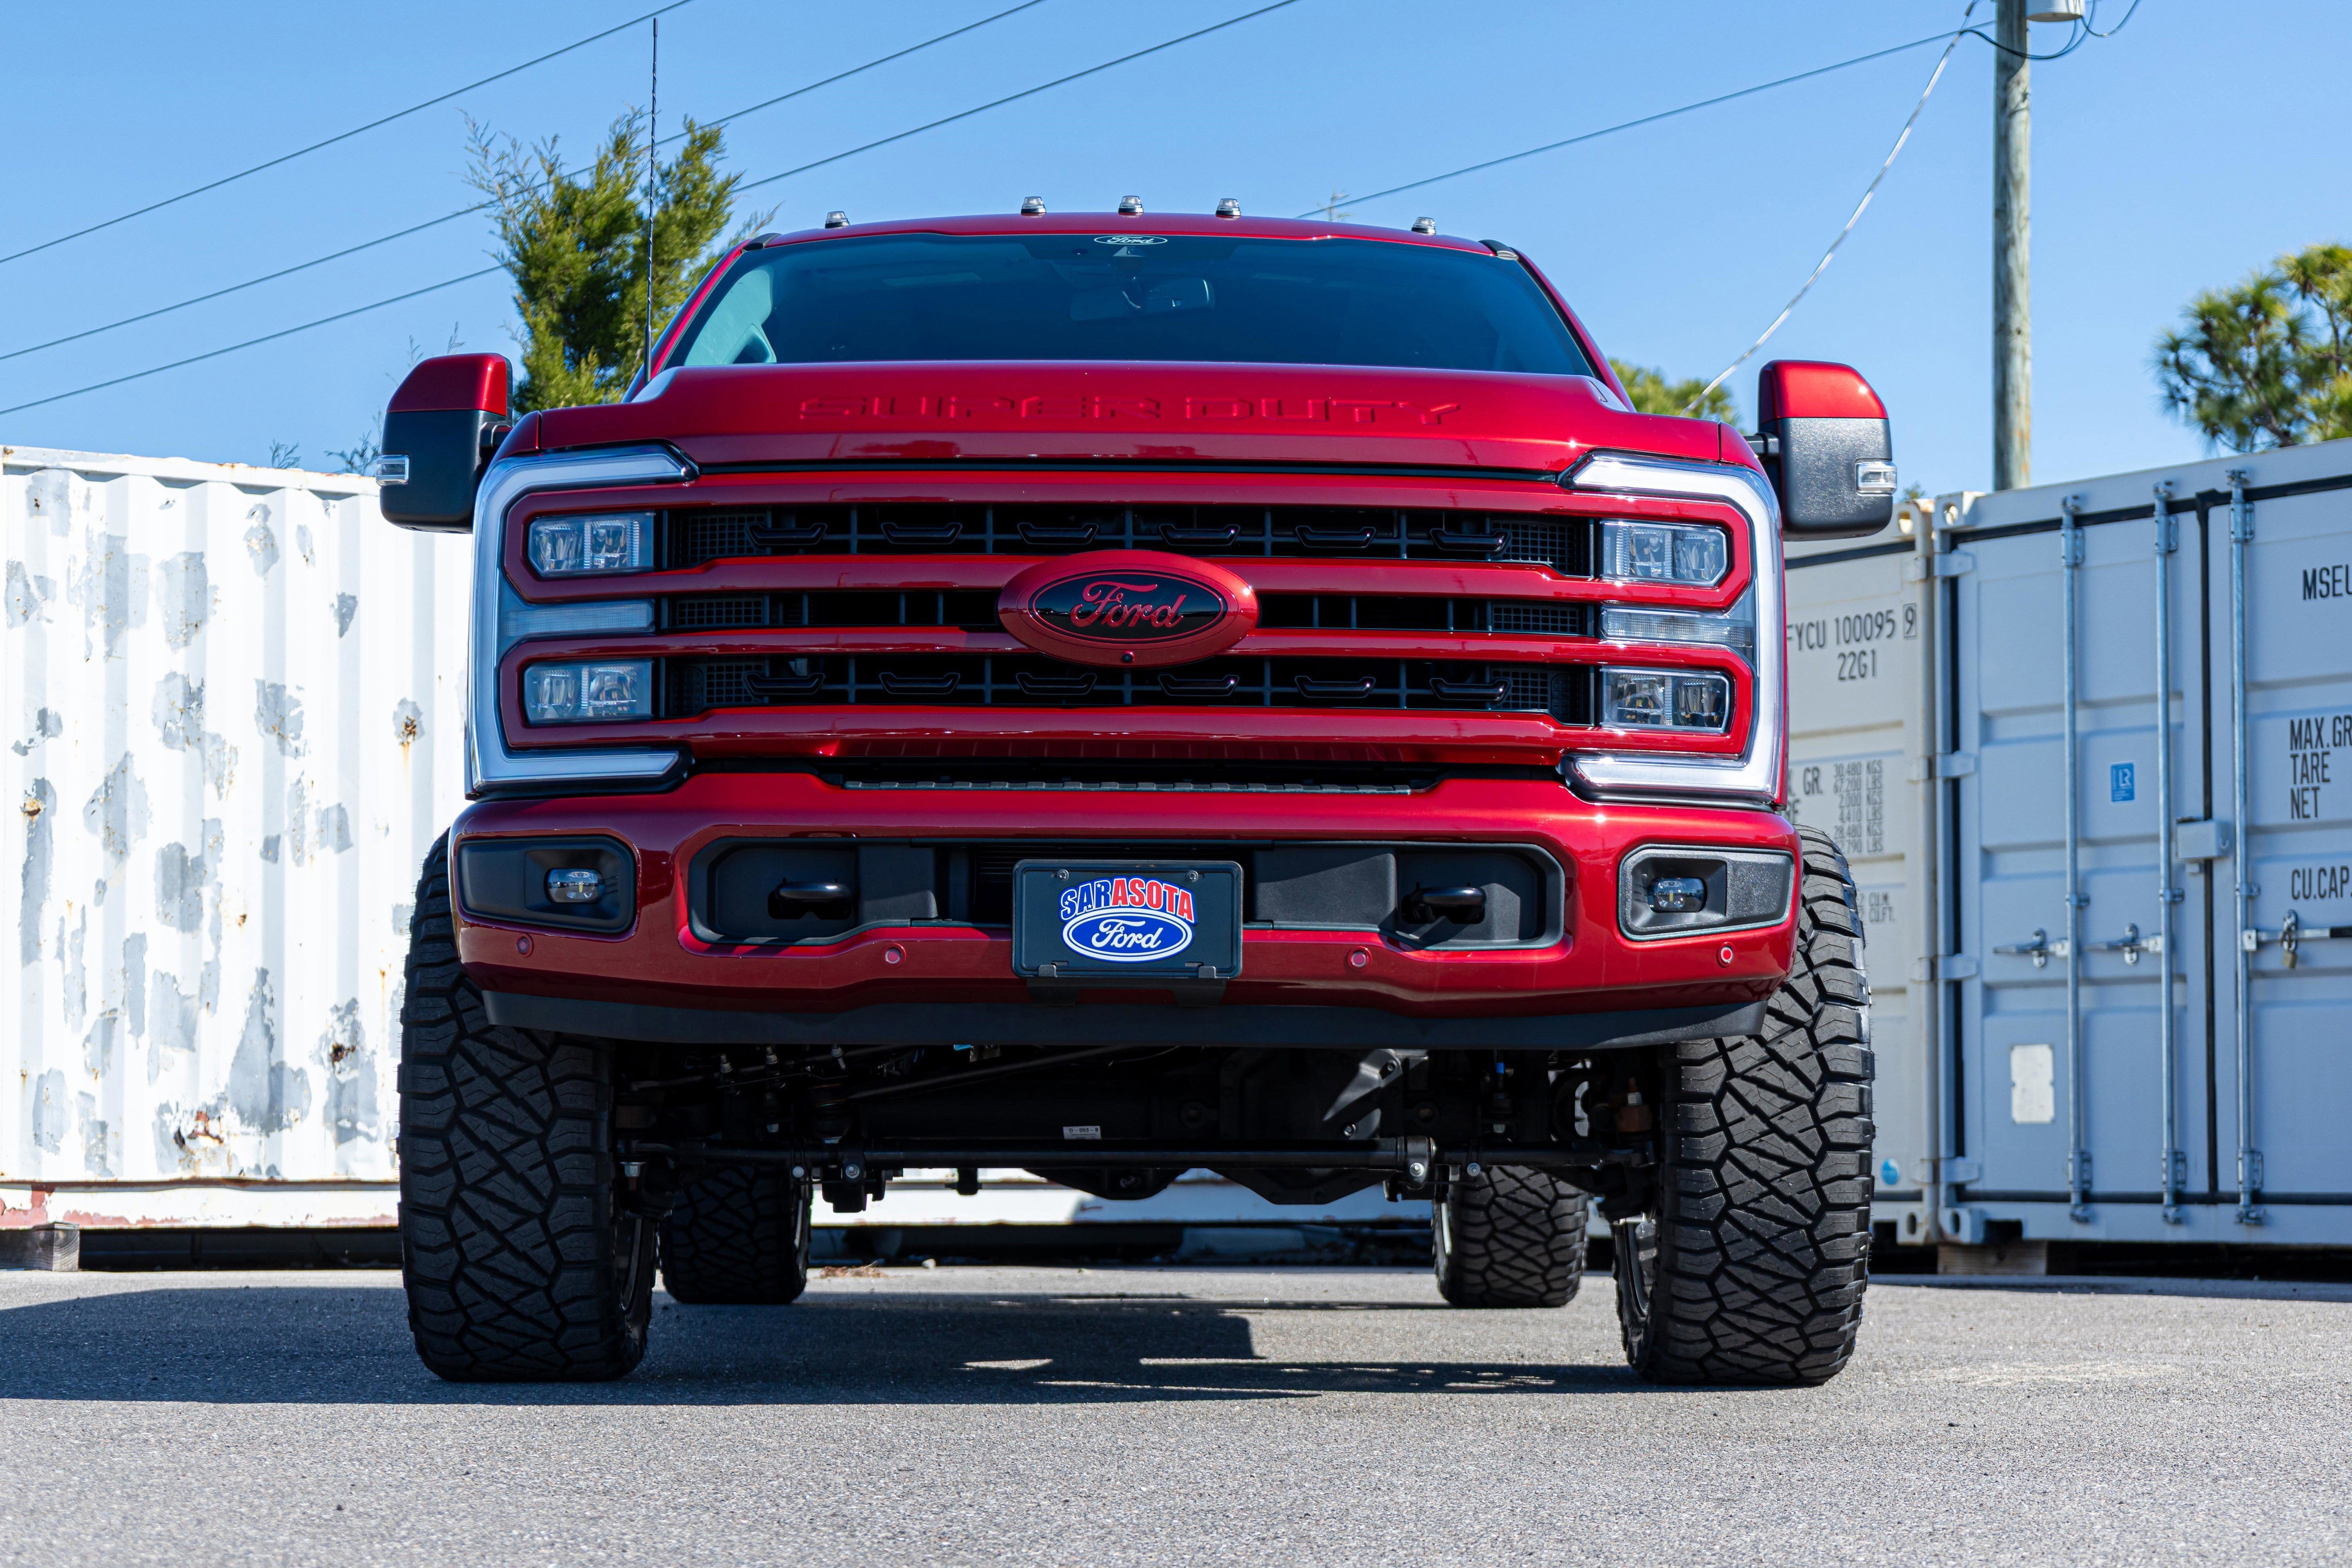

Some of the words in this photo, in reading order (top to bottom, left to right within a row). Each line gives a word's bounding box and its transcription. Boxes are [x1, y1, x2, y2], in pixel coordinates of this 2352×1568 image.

[800, 396, 1160, 421] SUPER
[1185, 396, 1461, 425] DUTY
[1069, 581, 1187, 628] Ford
[1834, 609, 1895, 645] 100095
[1904, 606, 1915, 635] 9
[1838, 648, 1876, 680] 22G1
[2290, 750, 2331, 784] TARE
[2290, 785, 2320, 819] NET
[1060, 876, 1196, 924] SARASOTA
[1091, 919, 1164, 949] Ford
